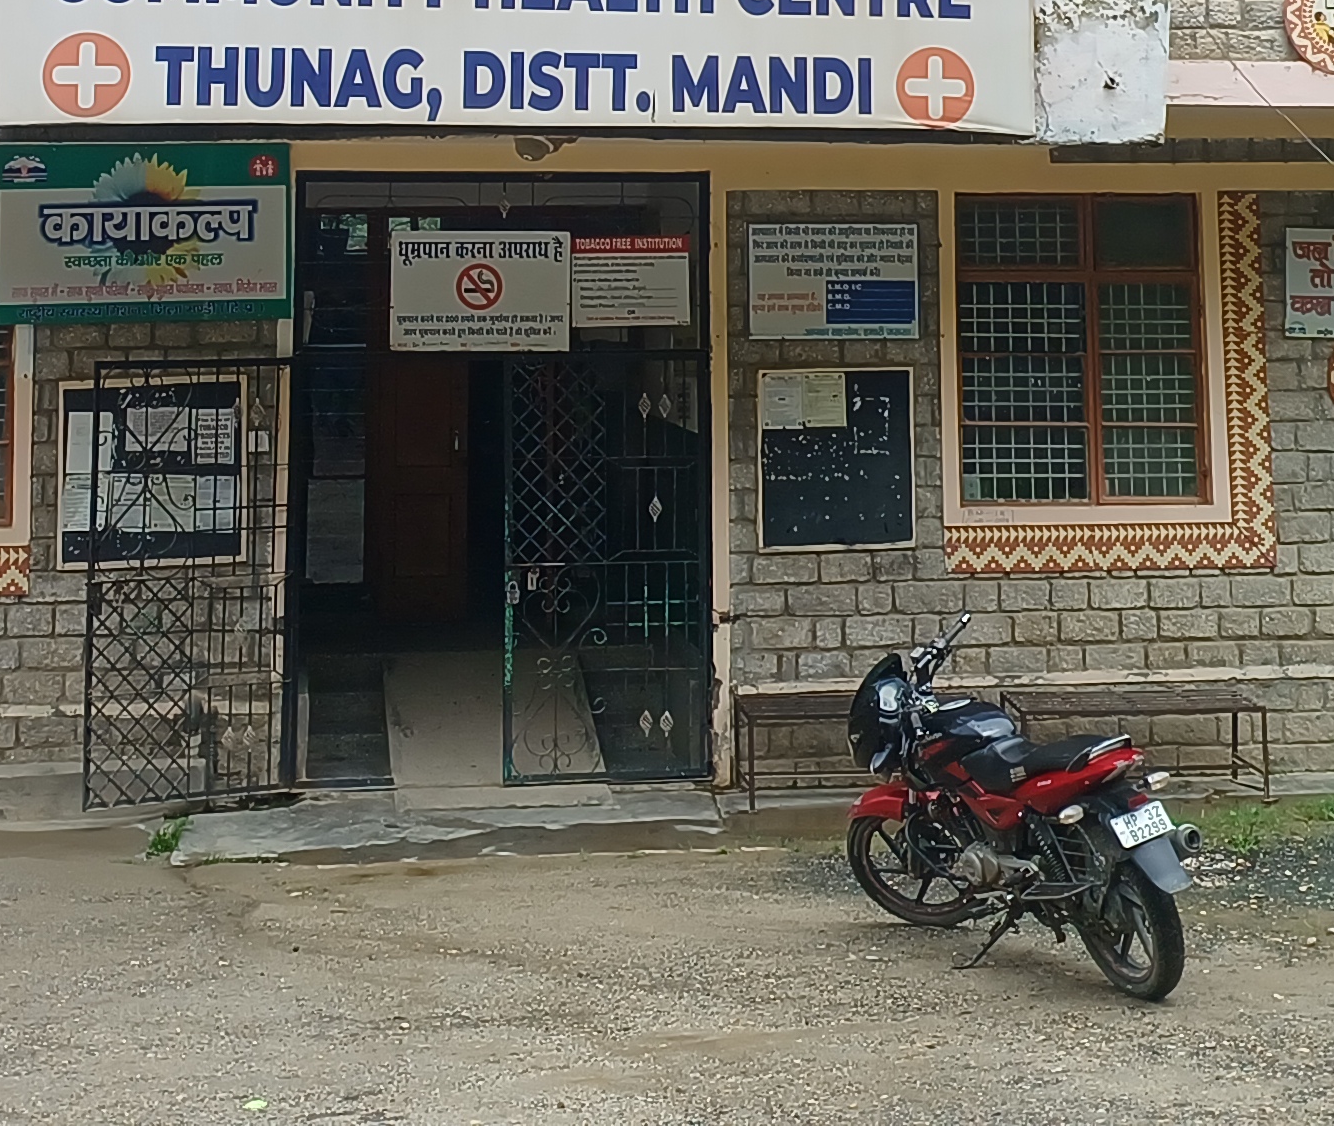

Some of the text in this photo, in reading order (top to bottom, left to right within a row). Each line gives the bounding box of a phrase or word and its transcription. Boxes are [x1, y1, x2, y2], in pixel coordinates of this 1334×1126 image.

[156, 46, 870, 119] THUNAG, DISTT. MANDI
[41, 203, 255, 244] कायाकल्प
[398, 235, 564, 267] धूम्रपान करना अपराध है
[575, 237, 683, 250] TOBACCO FREE INSTITUTION
[64, 255, 112, 269] स्वच्छता
[116, 252, 133, 267] की
[165, 254, 187, 267] एक
[191, 253, 223, 269] पहल
[1123, 814, 1138, 830] HP
[1129, 818, 1168, 843] B2299
